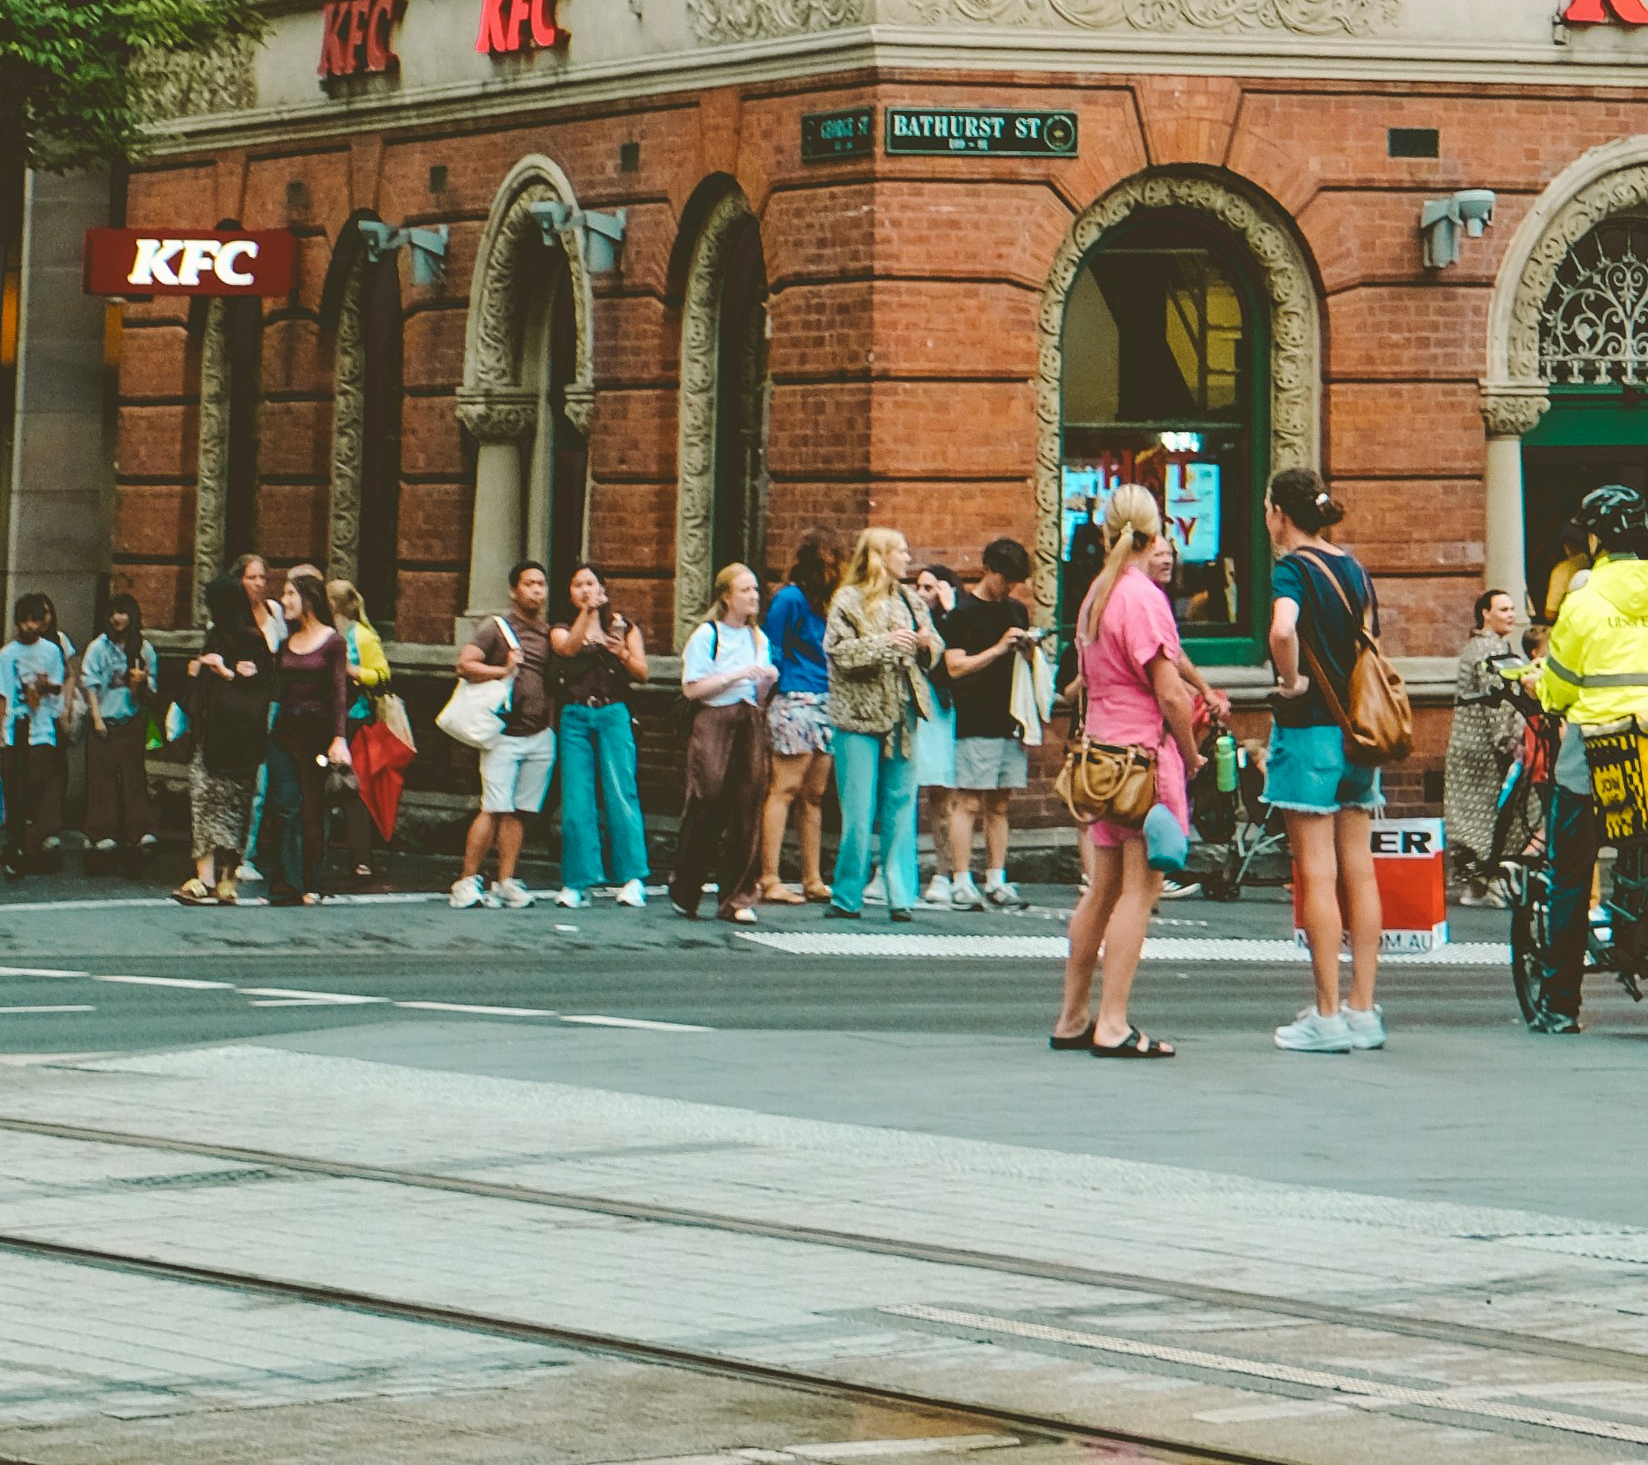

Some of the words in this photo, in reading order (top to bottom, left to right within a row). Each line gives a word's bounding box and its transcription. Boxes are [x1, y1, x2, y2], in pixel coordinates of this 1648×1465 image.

[893, 114, 1004, 138] BATHURST
[1014, 116, 1041, 139] ST
[127, 238, 259, 286] KFC
